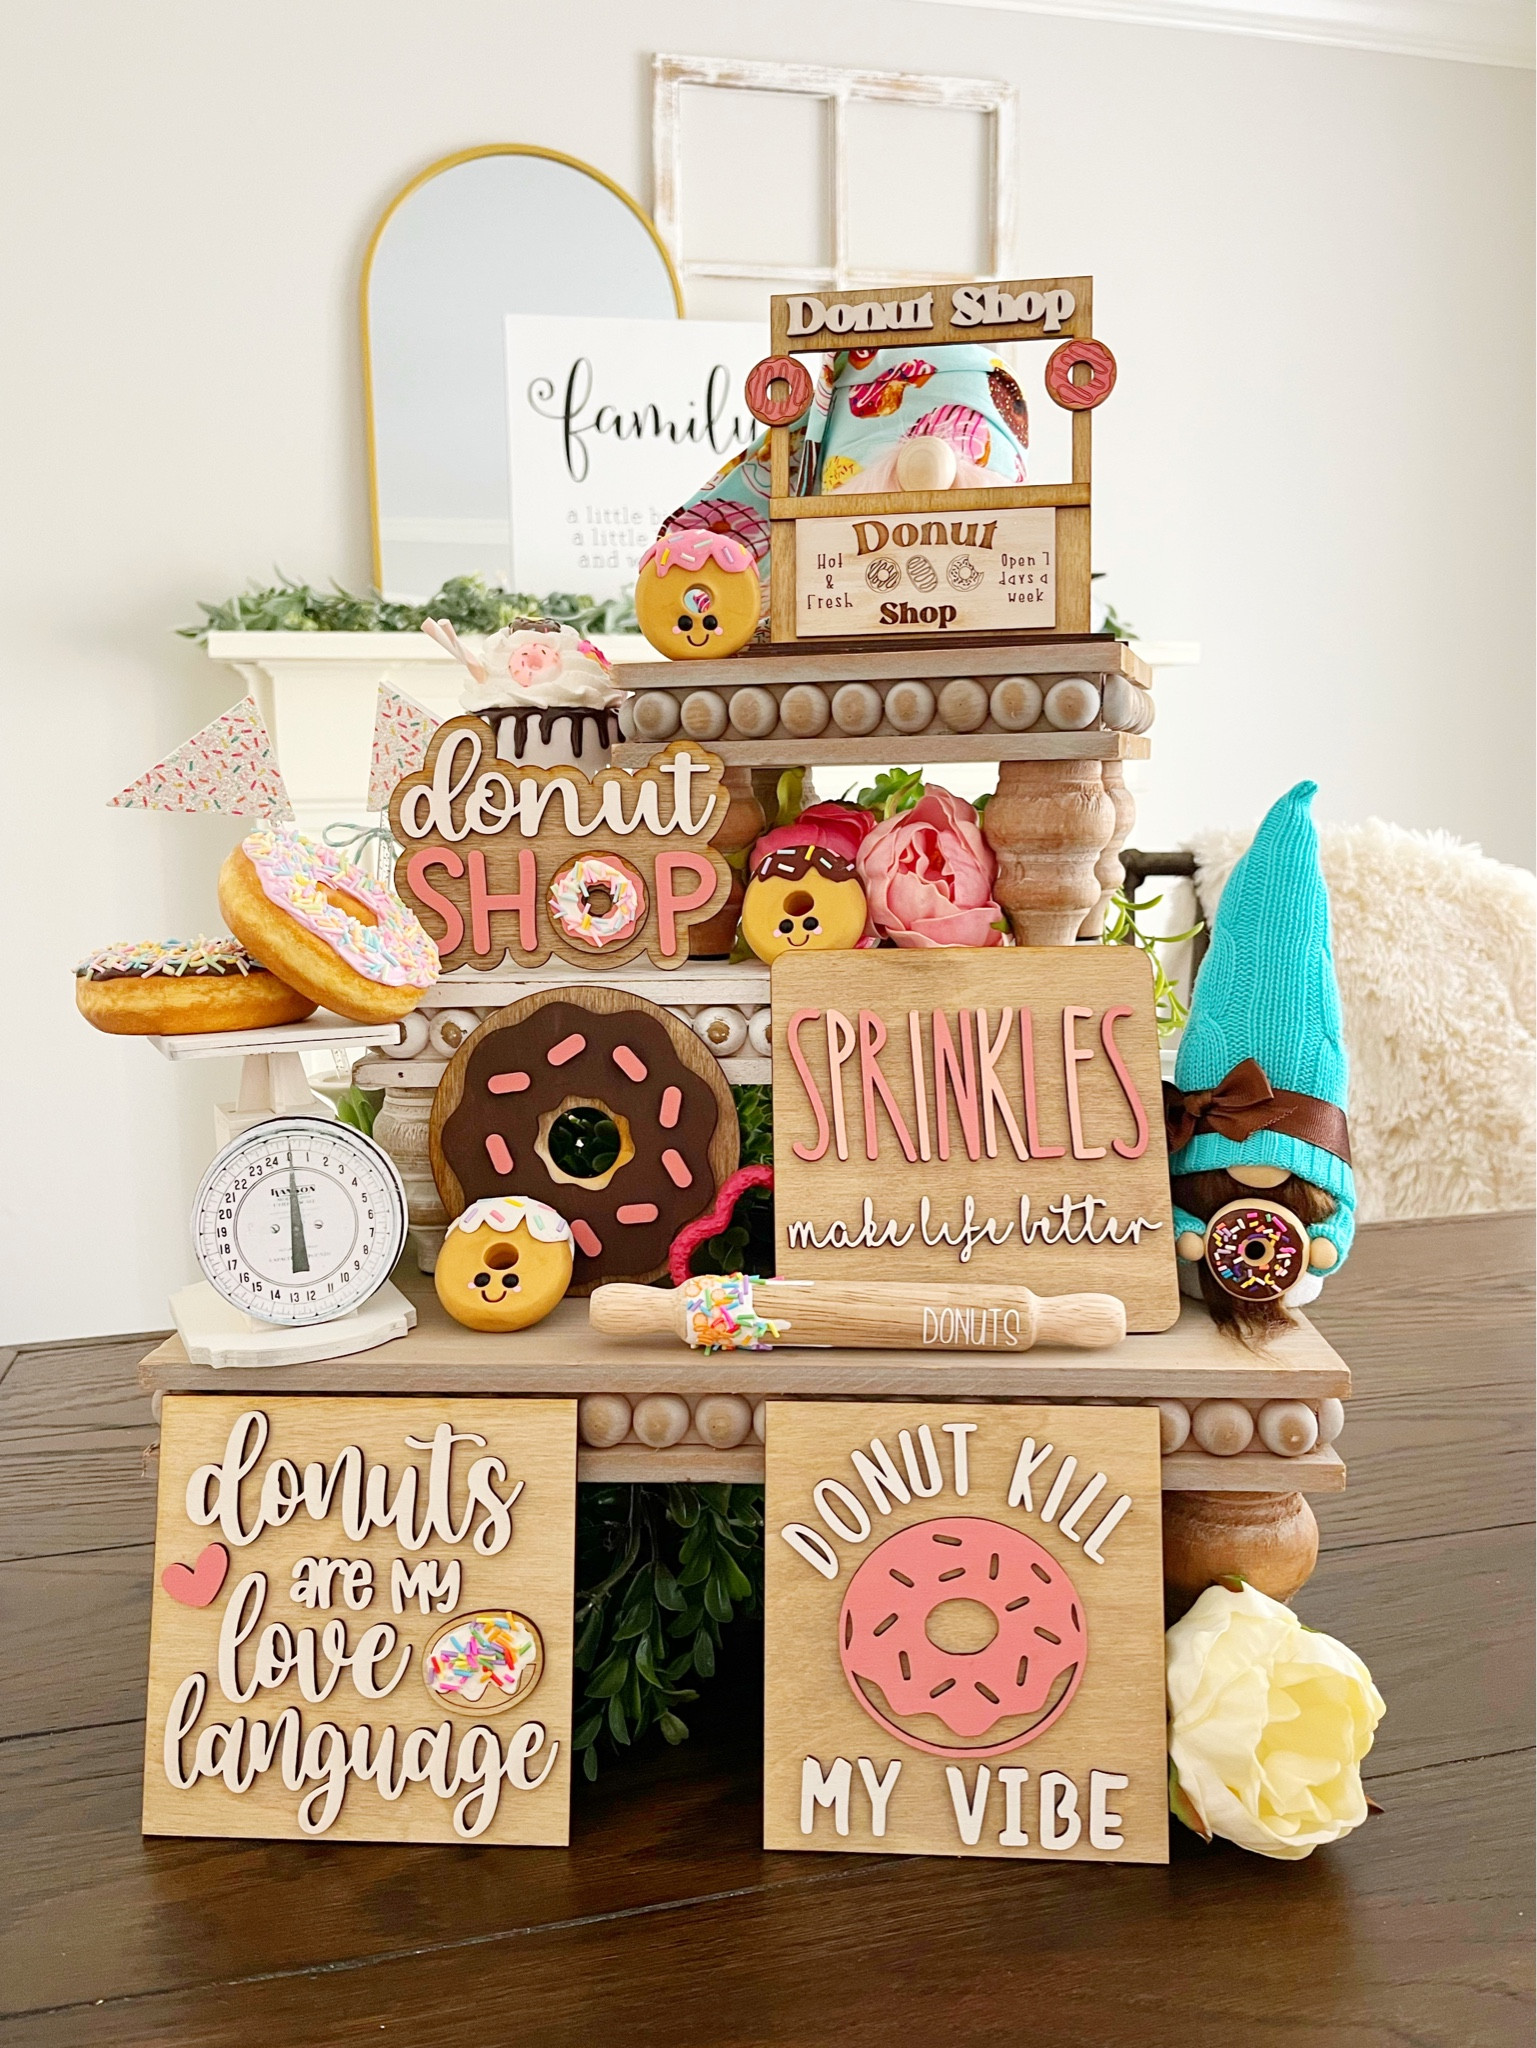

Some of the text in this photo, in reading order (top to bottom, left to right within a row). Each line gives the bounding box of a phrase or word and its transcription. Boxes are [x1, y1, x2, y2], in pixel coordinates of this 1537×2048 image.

[786, 285, 1076, 337] Donut Shop
[566, 510, 579, 524] a
[586, 505, 643, 525] little
[591, 527, 649, 547] little
[852, 520, 998, 556] Donut
[578, 549, 620, 569] and
[817, 552, 844, 570] Hot
[1001, 553, 1036, 569] Open
[825, 574, 835, 589] &
[998, 571, 1034, 586] days
[807, 592, 854, 610] Fresh
[1008, 587, 1044, 603] week
[879, 601, 957, 629] Shop
[400, 728, 717, 842] donut
[406, 846, 717, 957] SHOP
[786, 1004, 1150, 1163] SPRINKLES
[265, 1156, 279, 1168] 24
[306, 1151, 310, 1162] 1
[322, 1156, 329, 1167] 2
[249, 1165, 263, 1177] 23
[338, 1164, 345, 1175] 3
[233, 1179, 248, 1191] 22
[351, 1176, 358, 1187] 4
[225, 1192, 236, 1203] 21
[361, 1192, 368, 1203] 5
[218, 1209, 233, 1220] 20
[367, 1208, 374, 1220] 6
[216, 1226, 228, 1238] 19
[368, 1227, 375, 1238] 7
[787, 1192, 1163, 1264] make life better
[219, 1243, 231, 1255] 18
[362, 1244, 369, 1255] 8
[227, 1259, 238, 1271] 17
[353, 1259, 360, 1271] 9
[239, 1271, 250, 1284] 16
[340, 1271, 350, 1283] 10
[251, 1281, 263, 1293] 15
[327, 1283, 334, 1293] 11
[270, 1289, 281, 1301] 14
[289, 1292, 300, 1303] 13
[306, 1290, 316, 1301] 12
[922, 1306, 1021, 1347] DONUTS
[185, 1409, 526, 1557] donuts
[781, 1422, 1133, 1580] DONUT KILL
[289, 1556, 375, 1612] are
[217, 1570, 413, 1704] love
[162, 1671, 560, 1840] language
[799, 1754, 1130, 1851] MY VIBE
